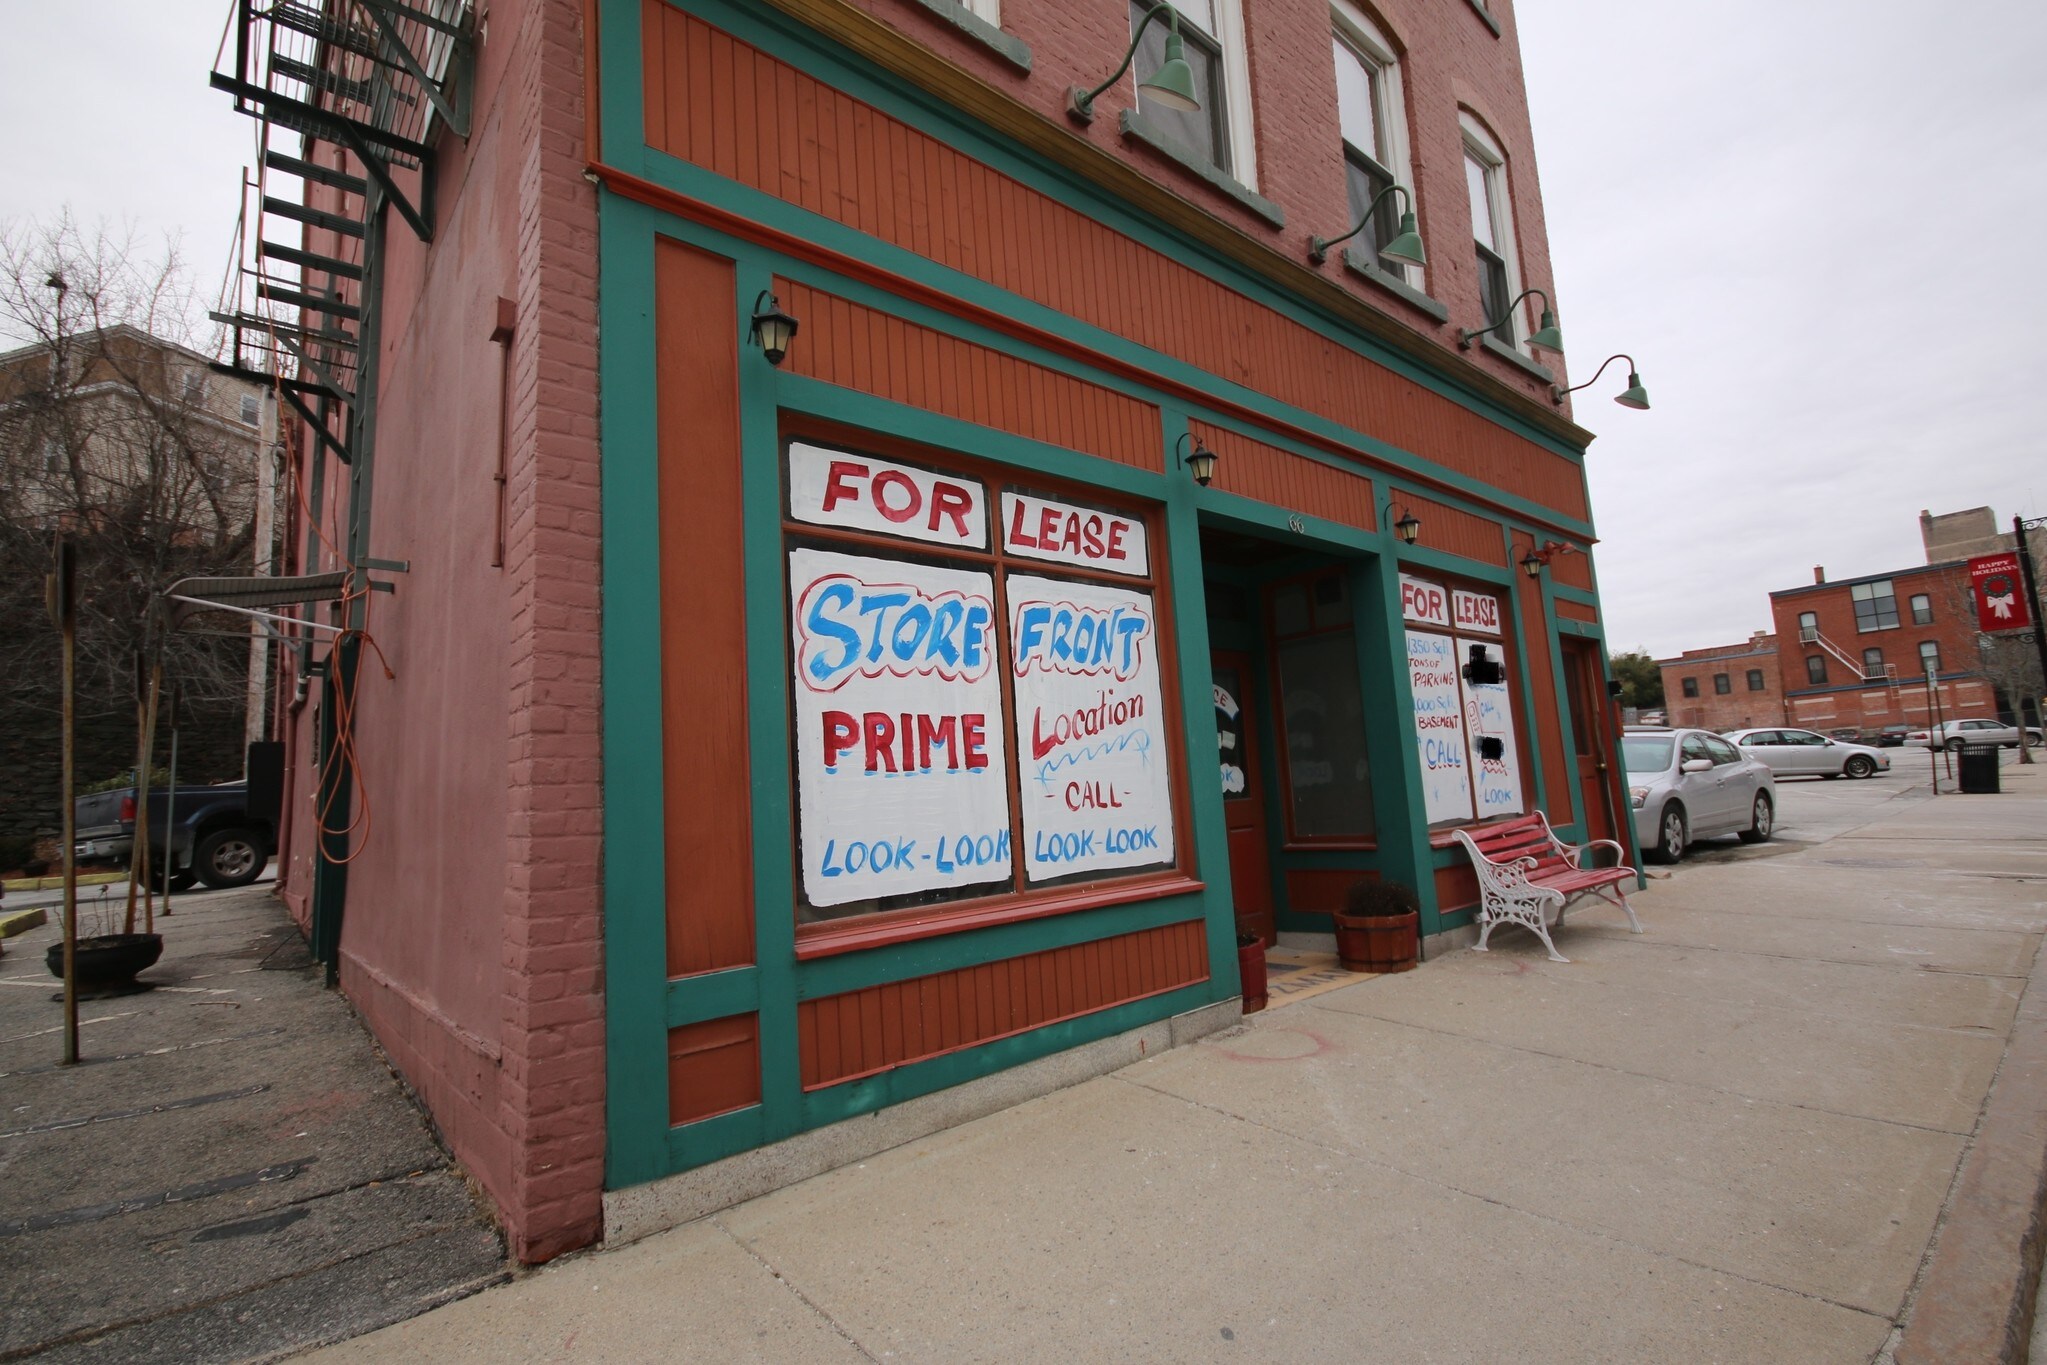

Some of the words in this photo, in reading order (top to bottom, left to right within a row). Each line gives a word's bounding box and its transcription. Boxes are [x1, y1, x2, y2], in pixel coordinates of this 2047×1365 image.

[821, 460, 973, 537] FOR
[1010, 498, 1130, 561] LEASE
[1288, 512, 1304, 534] 66
[1971, 564, 2018, 576] HOLIDAYS
[1977, 560, 2009, 570] HAPPY
[1402, 582, 1443, 621] FOR
[1455, 595, 1497, 627] LEASE
[808, 583, 989, 682] STORE
[1019, 607, 1146, 672] FRONT
[1413, 671, 1454, 688] PARKING
[821, 710, 989, 775] PRIME
[1032, 688, 1144, 761] Location
[1418, 714, 1459, 730] BASEMENT
[1425, 738, 1462, 766] CALL
[1484, 787, 1512, 804] LOOK
